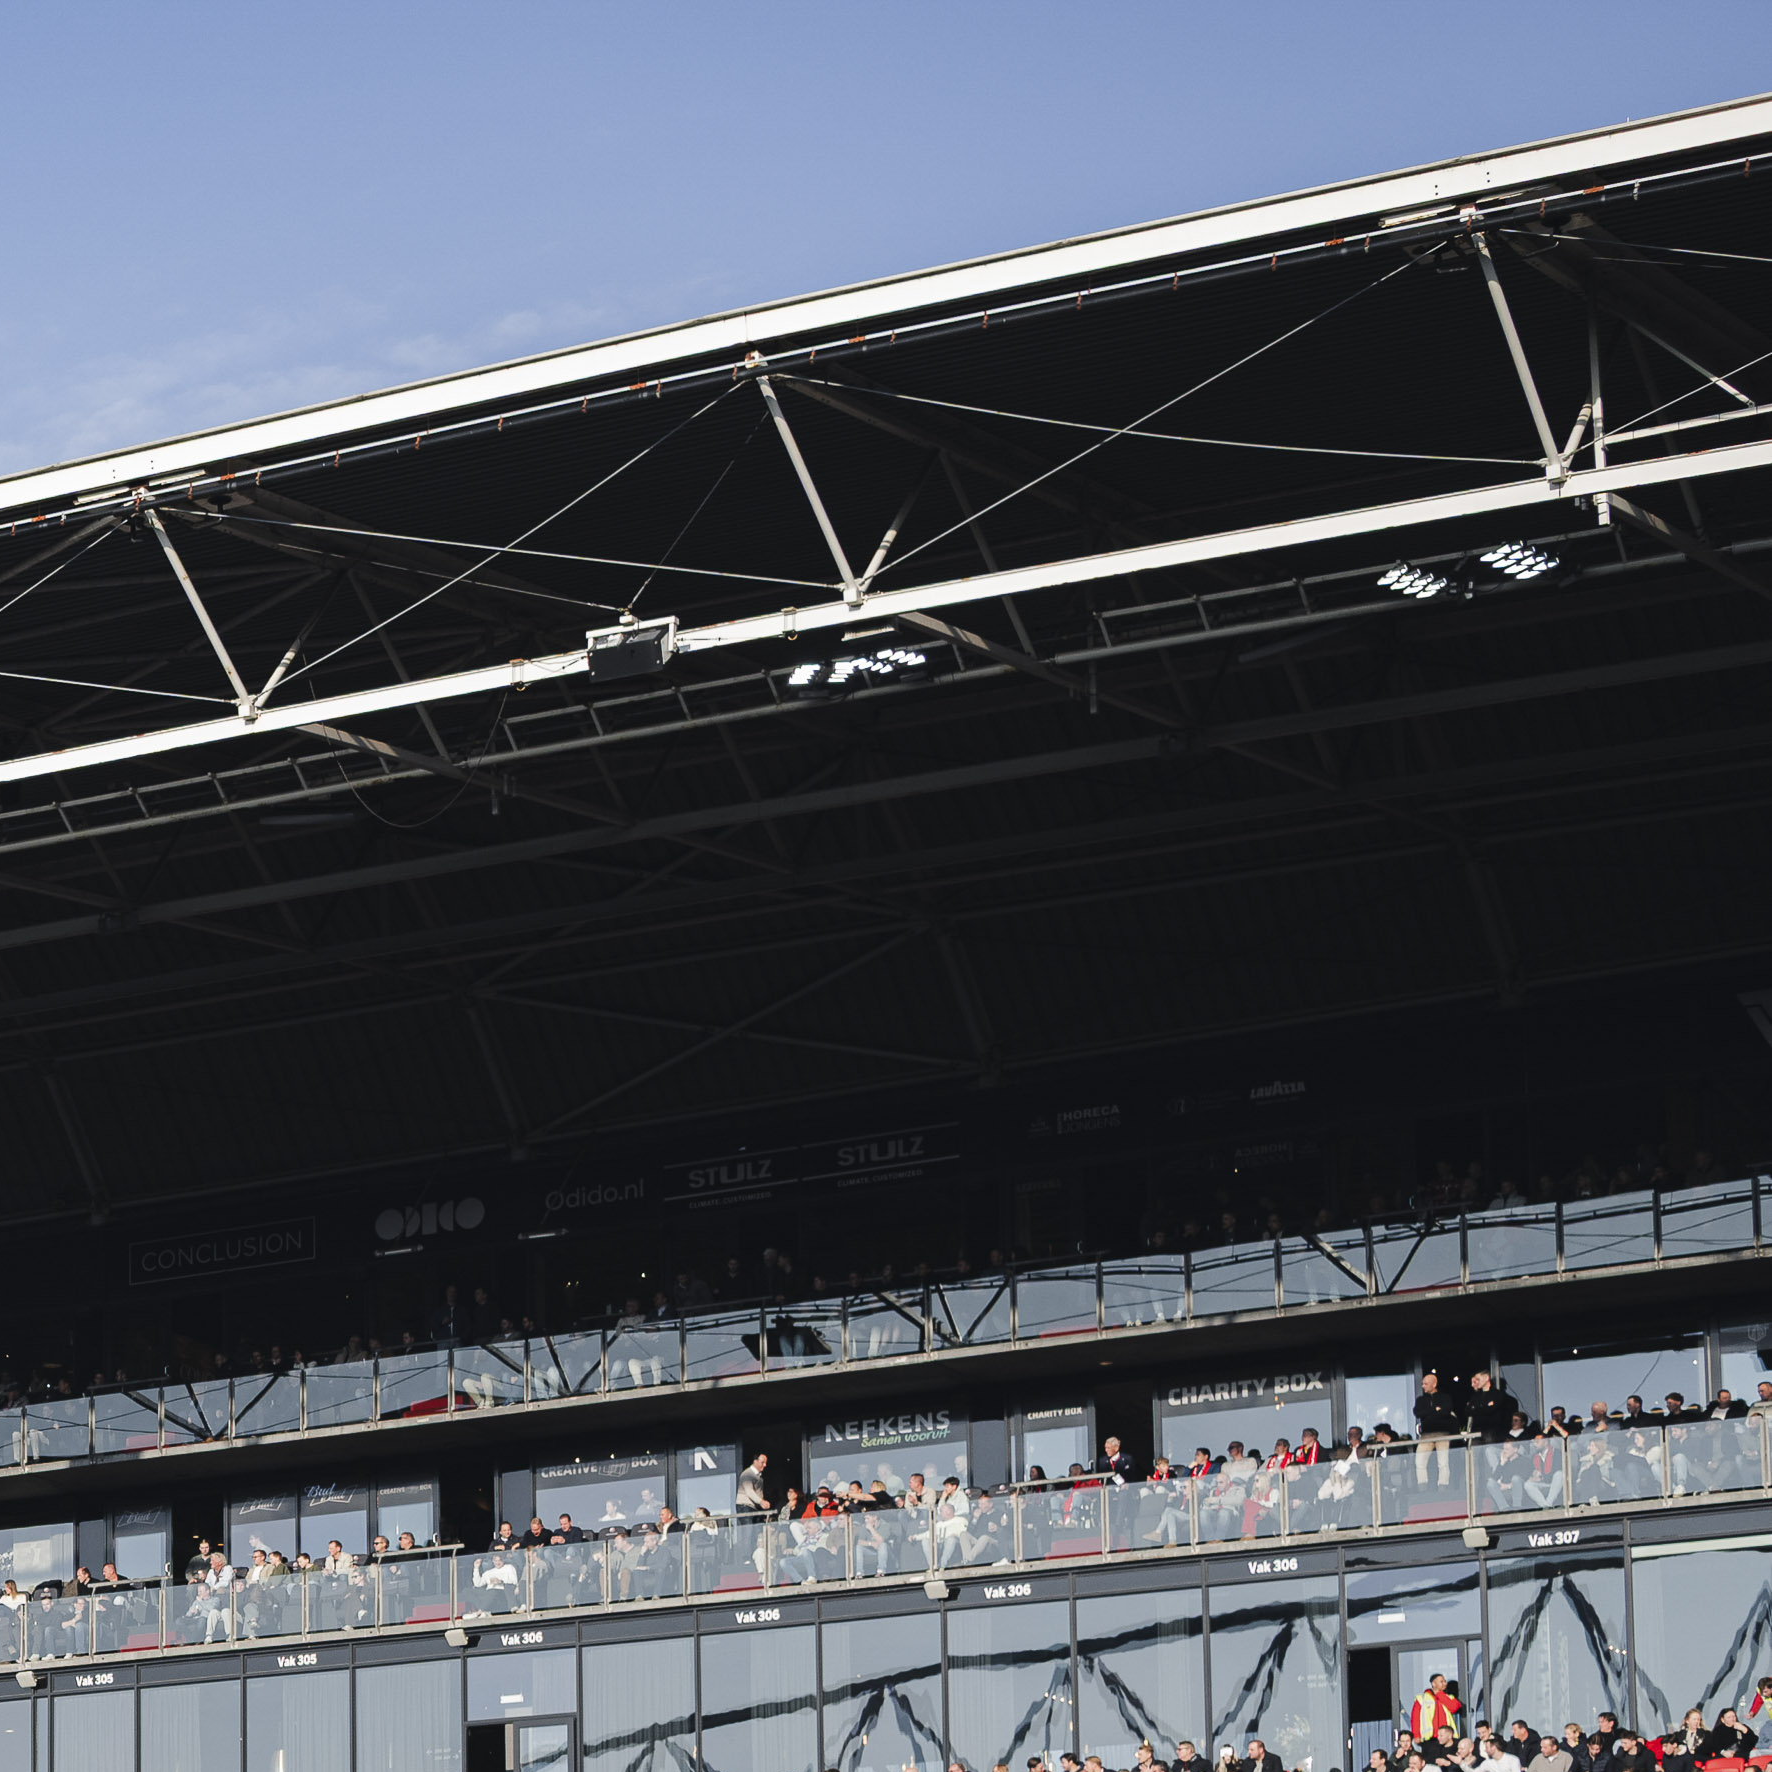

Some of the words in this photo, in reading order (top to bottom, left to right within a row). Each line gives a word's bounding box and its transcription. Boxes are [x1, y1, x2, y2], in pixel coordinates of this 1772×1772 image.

[1063, 1104, 1120, 1121] HORECA
[837, 1136, 924, 1166] STULZ
[689, 1159, 772, 1189] STULZ
[141, 1230, 302, 1273] CONCLUSION
[1168, 1379, 1267, 1406] CHARITY
[1274, 1372, 1324, 1395] BOX
[825, 1411, 951, 1443] NEFKENS
[540, 1462, 597, 1478] CREATIVE
[631, 1454, 658, 1468] BOX
[1528, 1533, 1553, 1547] Vak
[1555, 1530, 1580, 1544] 307
[1248, 1560, 1271, 1574] Vak
[1273, 1557, 1298, 1572] 306
[984, 1586, 1006, 1599] Vak
[1008, 1583, 1031, 1597] 306
[735, 1611, 756, 1624] Vak
[758, 1608, 780, 1622] 306
[501, 1633, 521, 1646] Vak
[522, 1631, 543, 1644] 306
[277, 1655, 296, 1667] Vak
[297, 1653, 317, 1666] 305
[76, 1675, 93, 1687] Vak
[95, 1673, 113, 1685] 305
